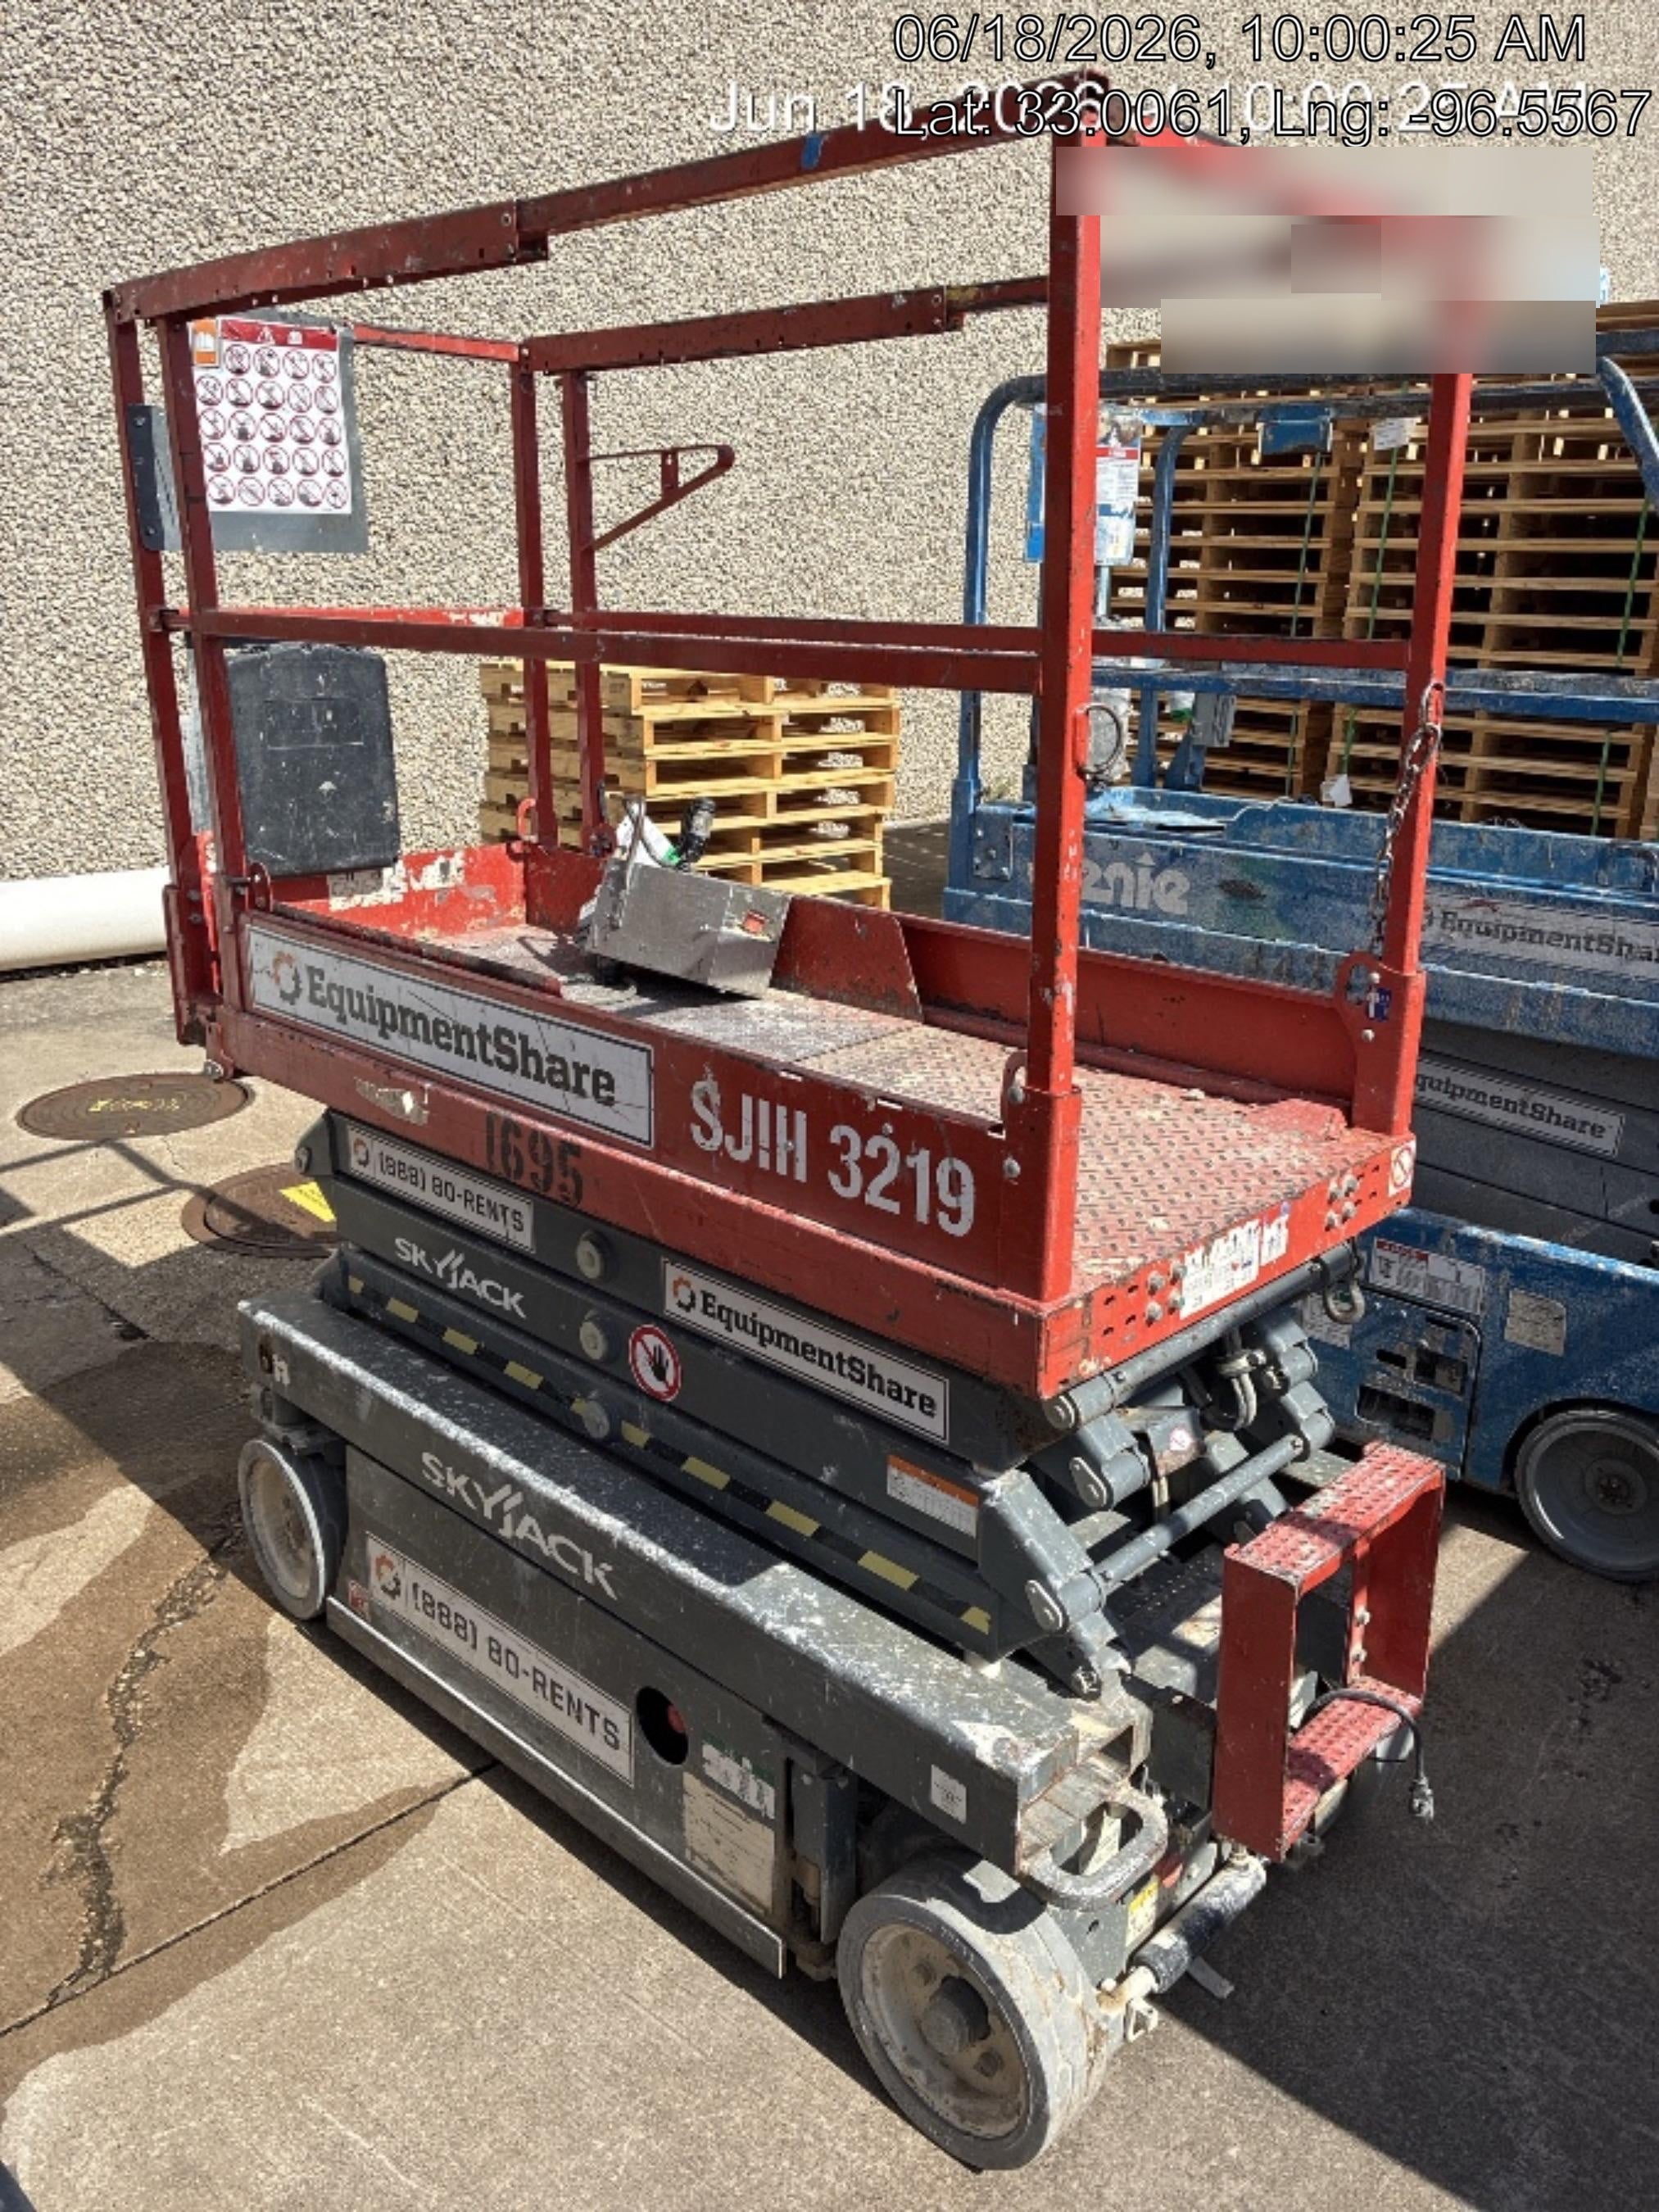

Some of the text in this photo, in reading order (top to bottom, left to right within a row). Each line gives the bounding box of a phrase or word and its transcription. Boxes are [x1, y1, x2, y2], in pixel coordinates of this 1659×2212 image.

[1027, 852, 1190, 914] enie
[306, 964, 615, 1107] EquipmentShare
[1416, 1073, 1606, 1139] quipmentShare
[378, 1151, 525, 1232] (888) 80-RENTS
[486, 1111, 583, 1207] 1695
[828, 1124, 976, 1237] 3219
[394, 1236, 526, 1319] SKYJACK
[700, 1289, 936, 1420] EquipmentShare
[420, 1451, 618, 1600] SKYJACK
[412, 1582, 620, 1751] (888) 80-RENTS
